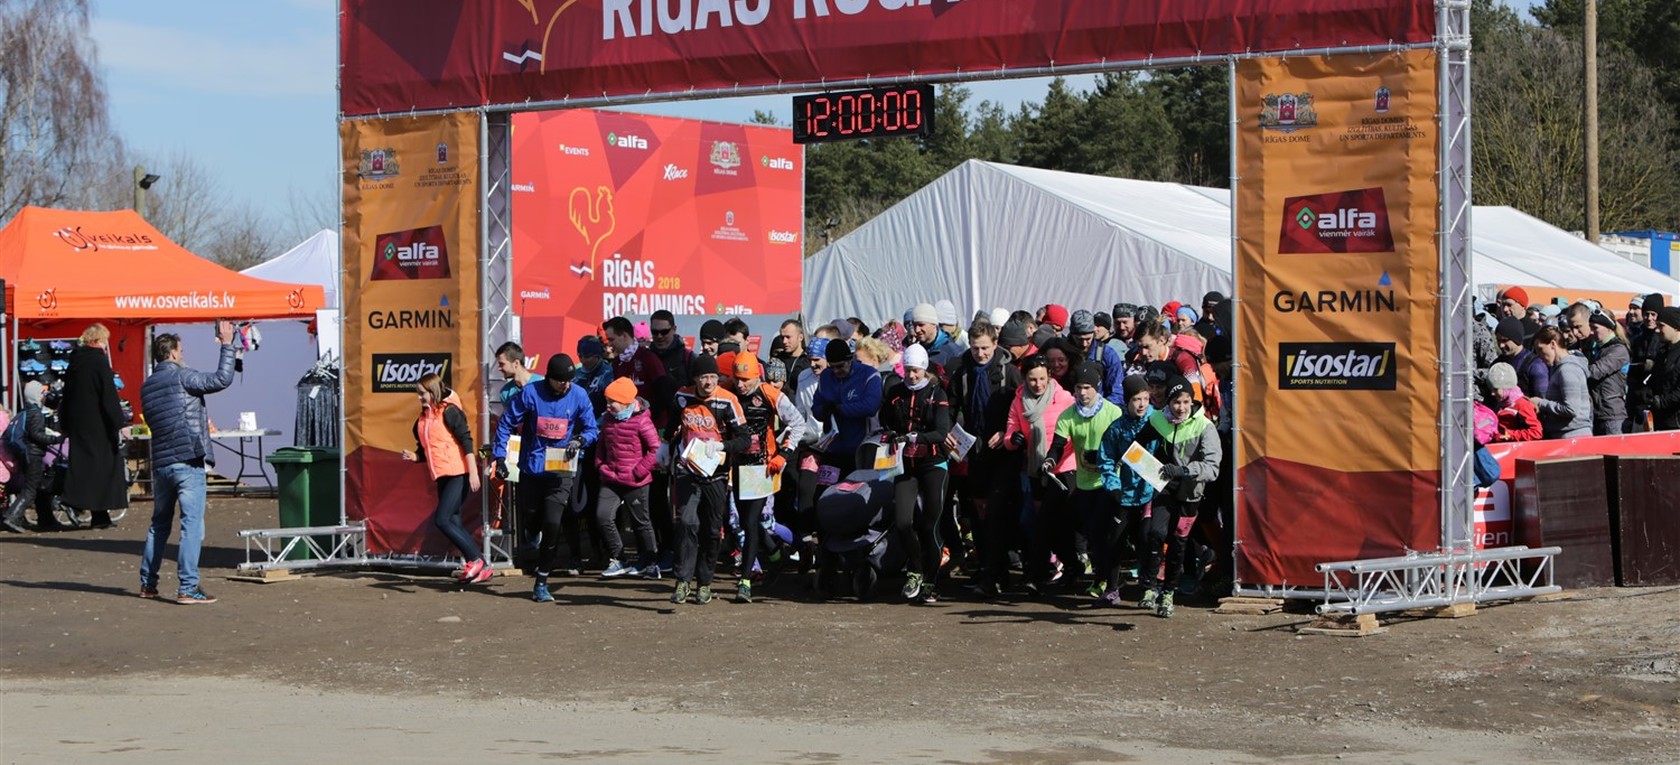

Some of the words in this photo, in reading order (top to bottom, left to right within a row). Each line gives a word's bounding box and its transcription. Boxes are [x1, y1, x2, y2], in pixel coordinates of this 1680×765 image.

[806, 89, 922, 137] 12:00:00
[617, 135, 648, 149] alfa
[565, 147, 589, 156] EVENTS
[769, 158, 793, 170] alfa
[511, 184, 534, 192] ARMIN
[1317, 208, 1376, 229] alfa
[397, 242, 439, 259] alfa
[603, 254, 654, 289] RĪGAS
[658, 277, 680, 289] 2018
[115, 291, 235, 309] www.osveikals.lv
[521, 290, 550, 299] GARMIN
[544, 422, 560, 431] 306
